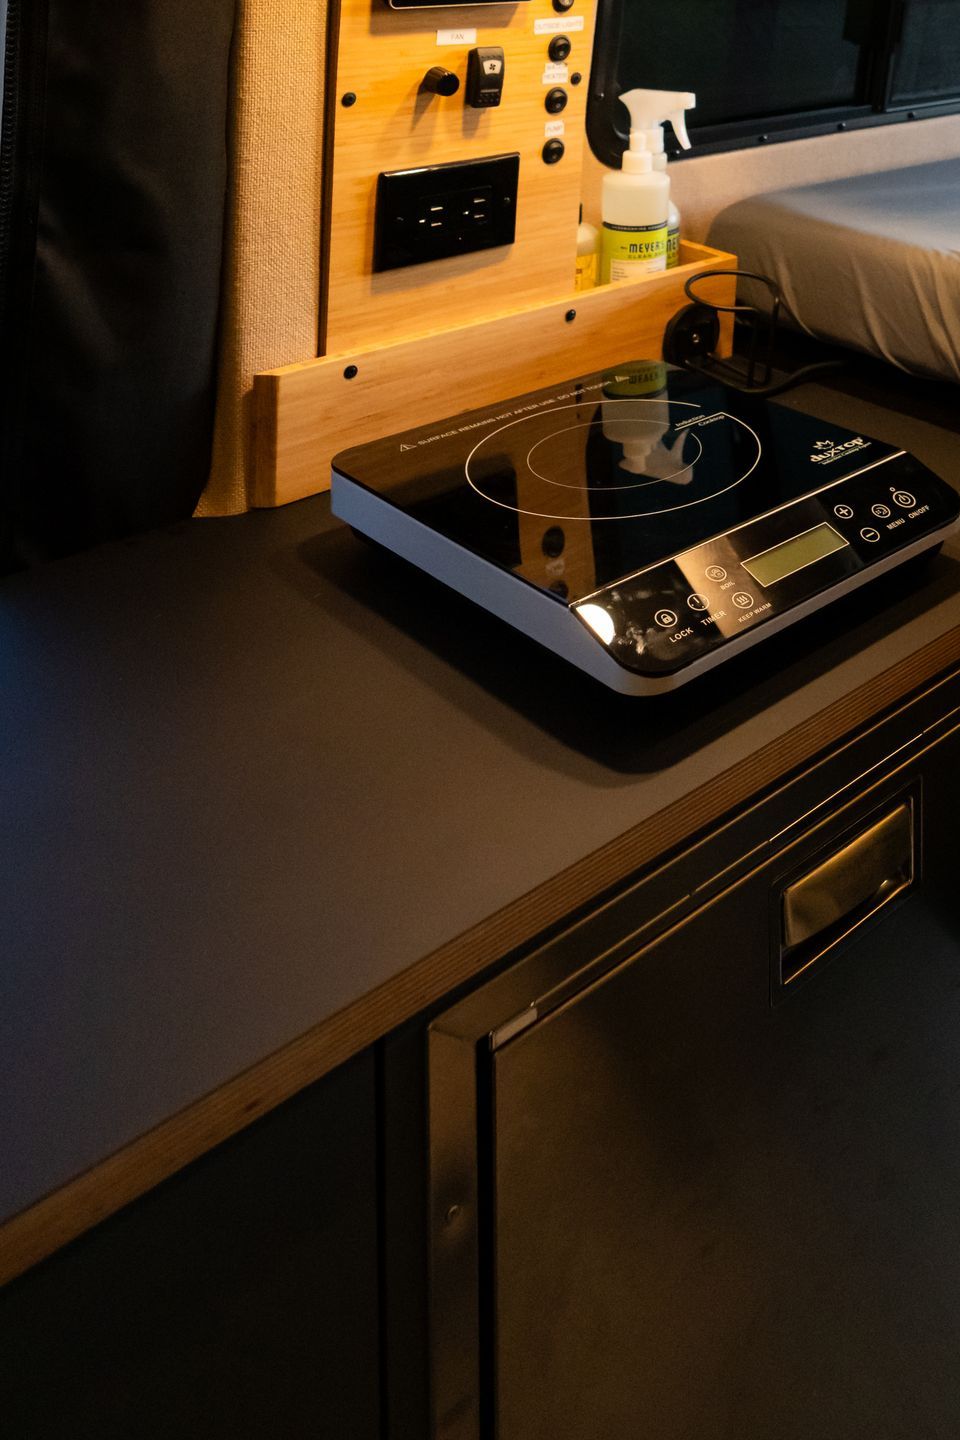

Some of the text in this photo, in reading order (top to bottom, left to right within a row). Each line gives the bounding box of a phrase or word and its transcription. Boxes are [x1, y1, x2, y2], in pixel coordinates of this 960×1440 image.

[675, 414, 706, 427] Induction
[417, 430, 459, 445] SURFACE
[908, 505, 930, 519] ON/OFF
[886, 517, 906, 530] MENU
[720, 580, 736, 591] BOIL
[700, 610, 727, 626] TIMER
[737, 602, 772, 623] KEEP WARM
[669, 627, 694, 643] LOCK
